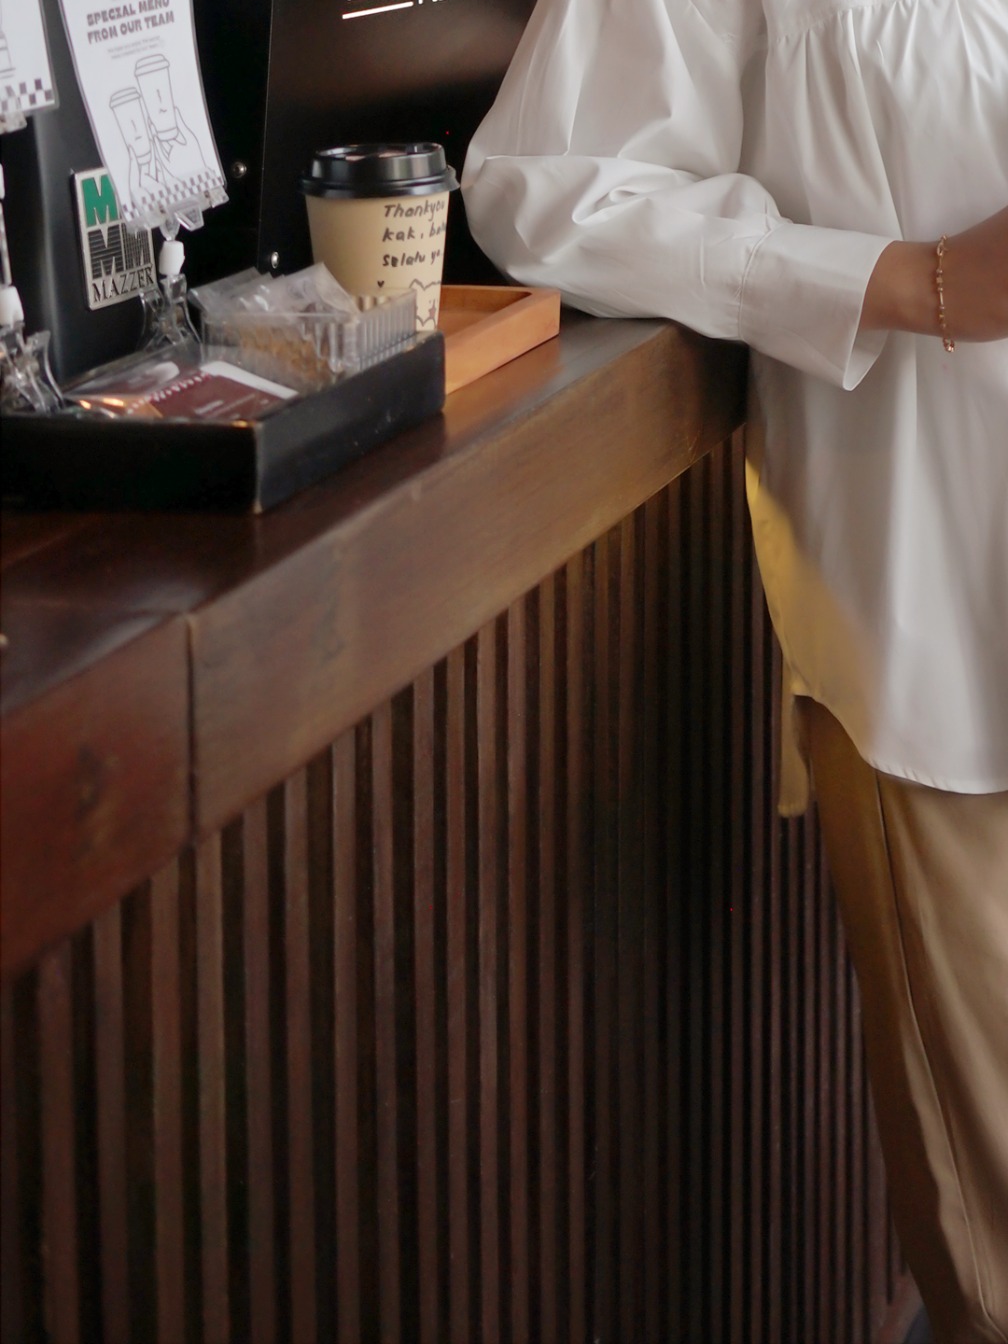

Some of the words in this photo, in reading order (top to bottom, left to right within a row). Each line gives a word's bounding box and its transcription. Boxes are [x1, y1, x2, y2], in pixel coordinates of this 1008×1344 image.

[86, 3, 136, 26] SPECIAL
[87, 25, 118, 44] FROM
[119, 18, 142, 36] OUR
[144, 10, 175, 29] TEAM
[92, 265, 154, 303] MAZZER
